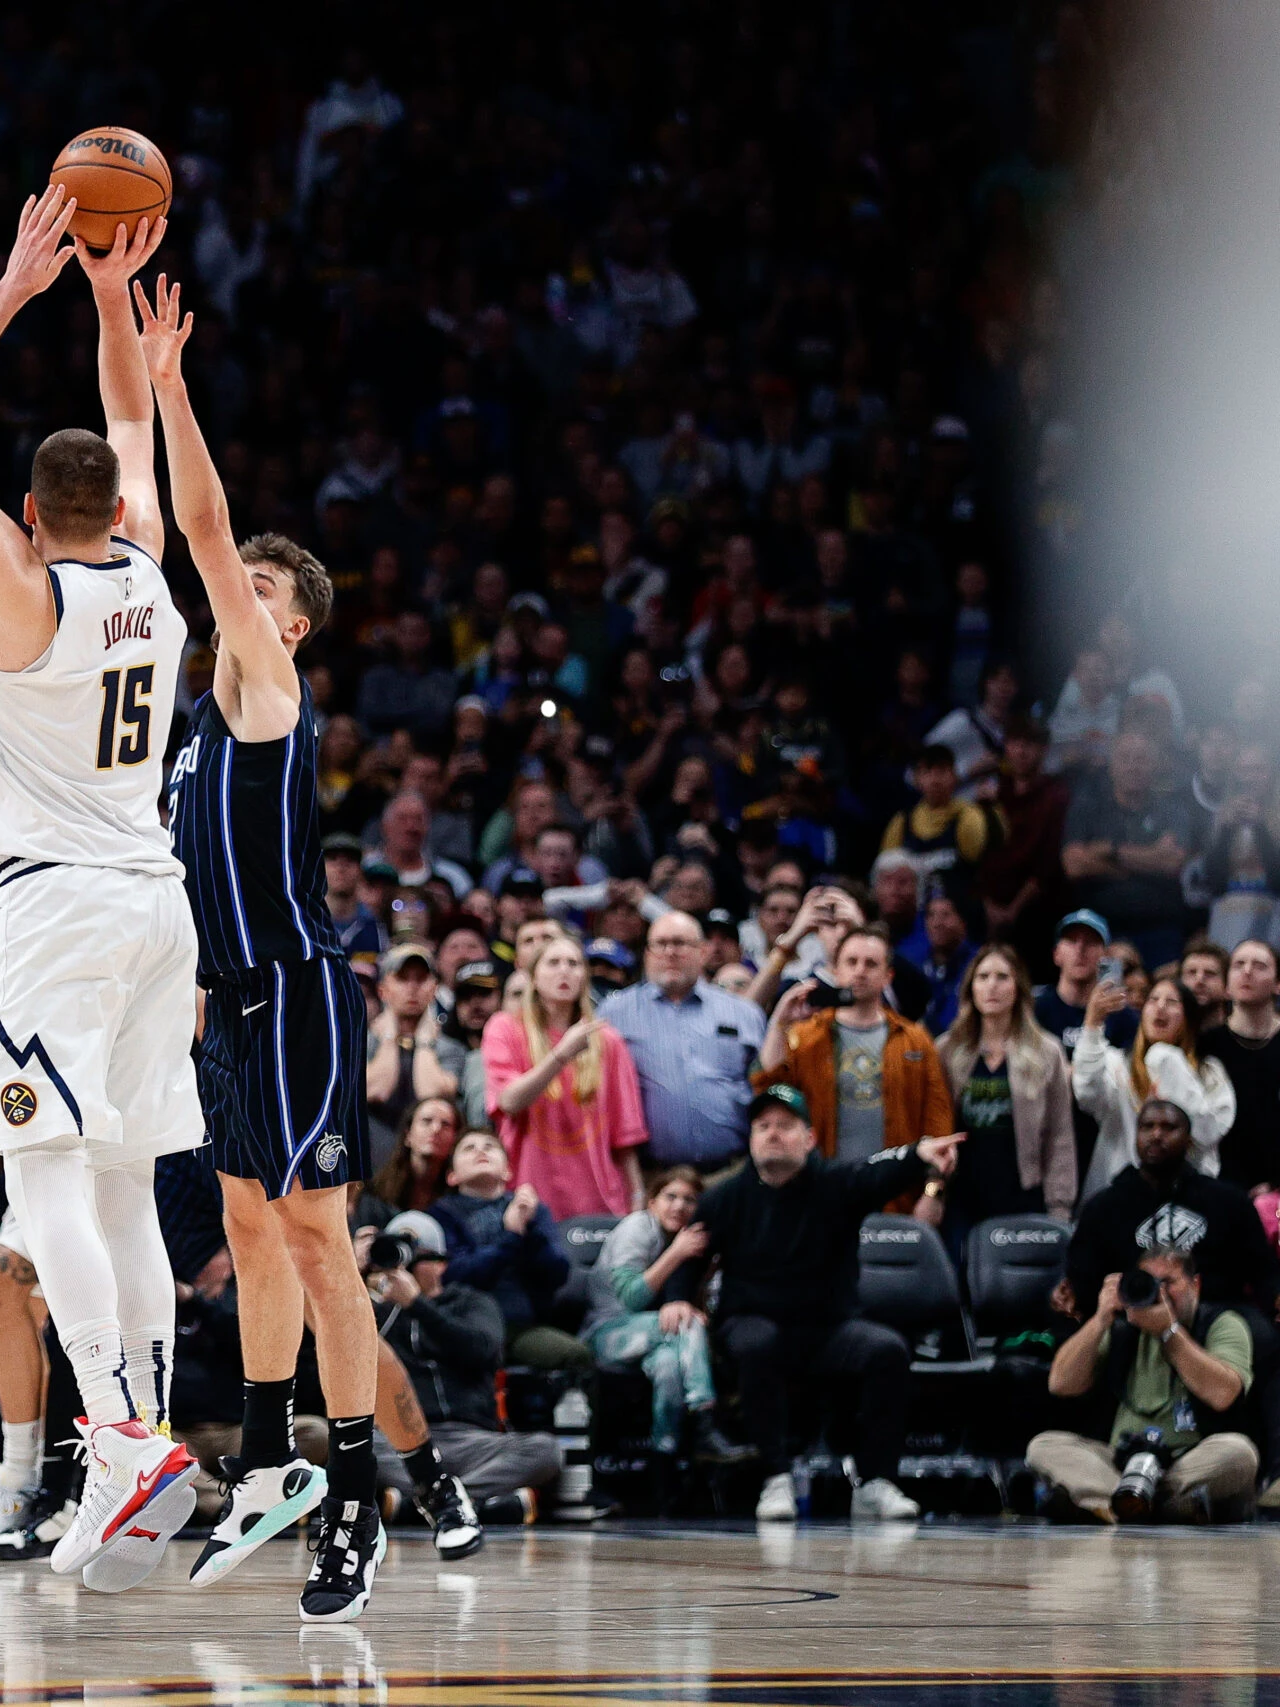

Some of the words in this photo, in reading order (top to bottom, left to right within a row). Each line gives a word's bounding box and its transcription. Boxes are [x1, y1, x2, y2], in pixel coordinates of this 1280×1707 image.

[68, 137, 146, 167] Wilson
[103, 600, 155, 652] JOKIĆ
[95, 661, 157, 772] 15
